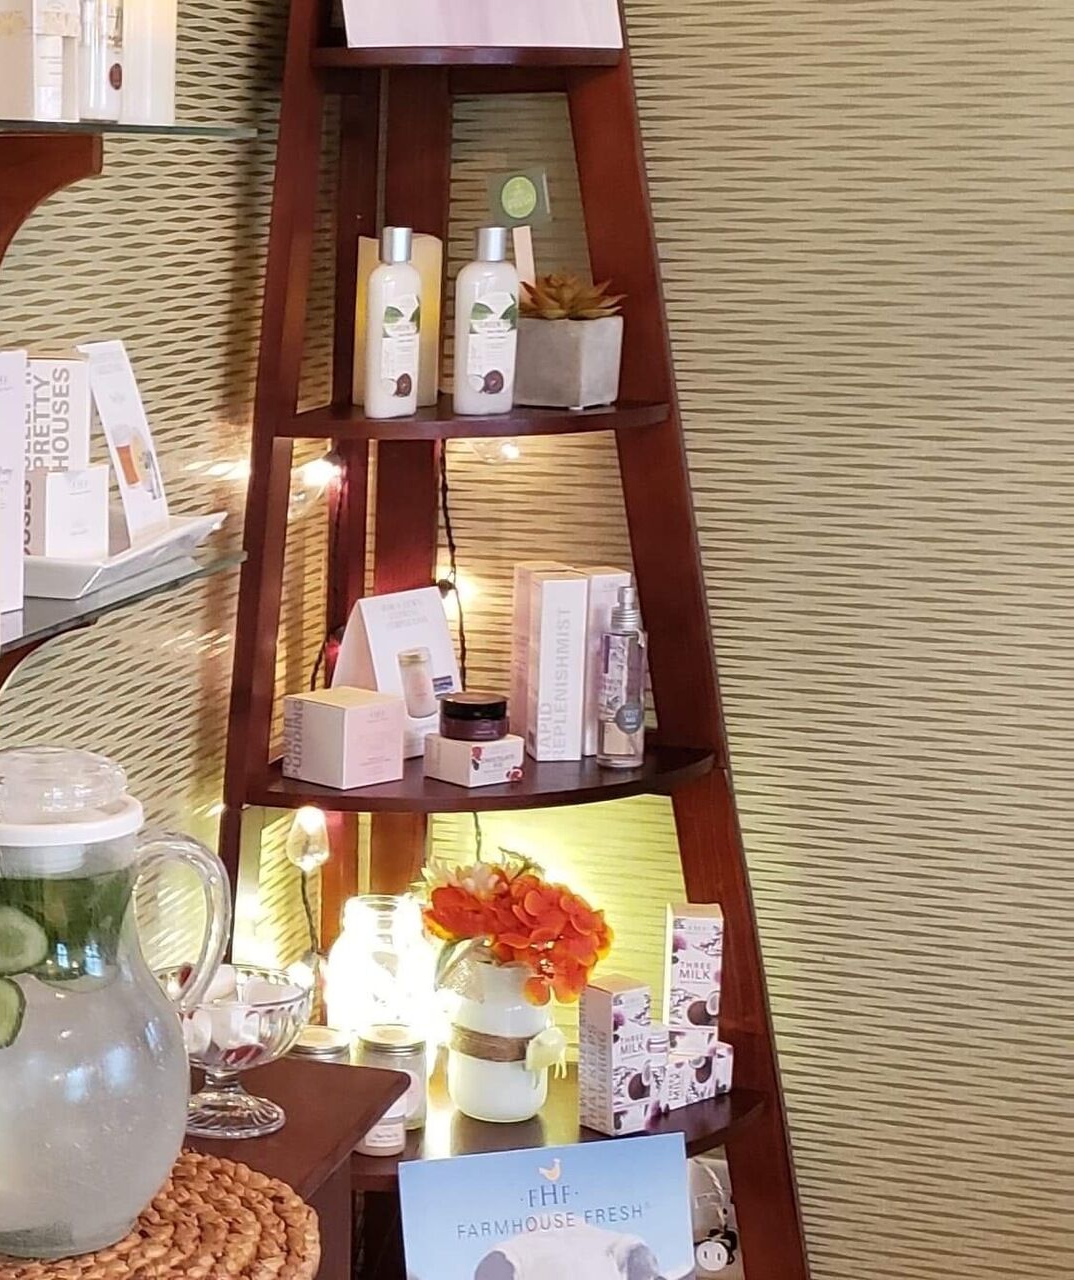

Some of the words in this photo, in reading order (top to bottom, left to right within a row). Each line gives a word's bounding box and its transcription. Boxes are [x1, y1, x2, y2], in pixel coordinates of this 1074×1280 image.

[33, 375, 50, 471] PRETTY
[52, 367, 70, 472] HOUSES
[679, 969, 711, 980] MILK
[620, 1041, 644, 1055] MILK
[528, 1184, 571, 1207] FHF
[457, 1212, 575, 1239] FARMHOUSE
